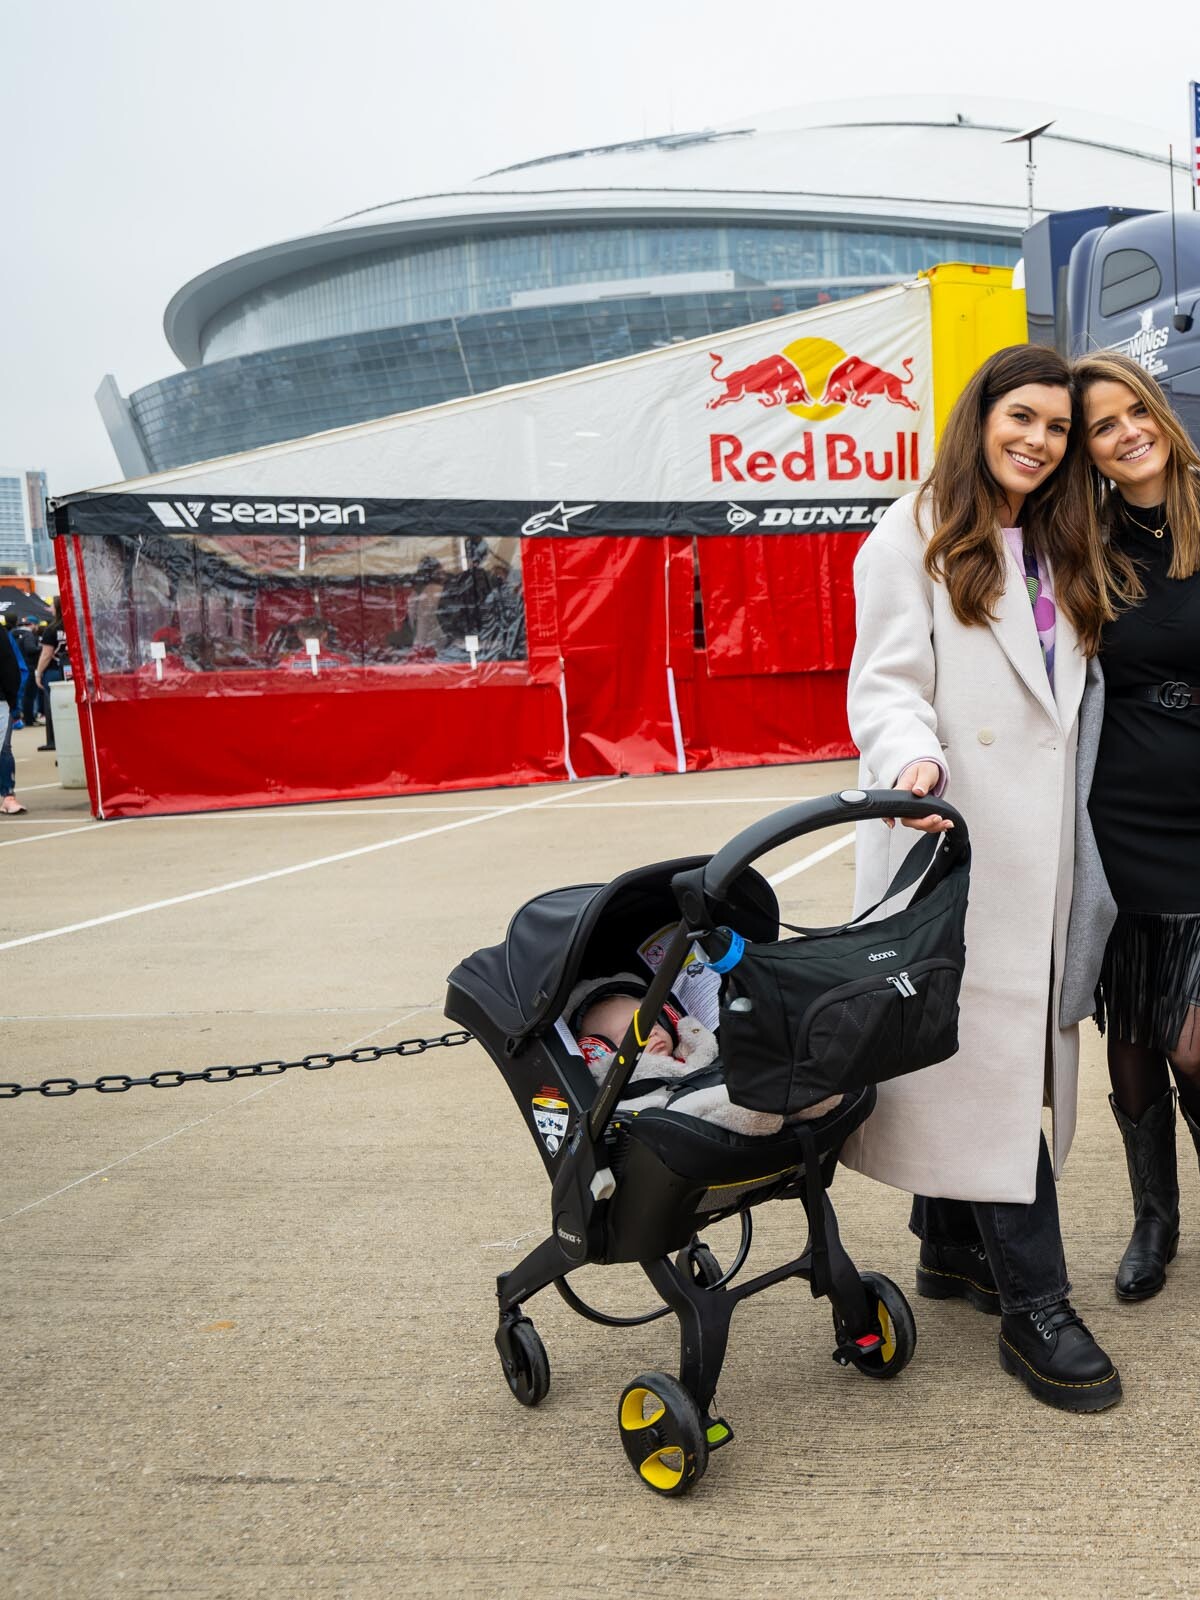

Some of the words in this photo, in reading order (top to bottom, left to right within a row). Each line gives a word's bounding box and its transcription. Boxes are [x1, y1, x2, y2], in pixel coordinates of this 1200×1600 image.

[1129, 327, 1169, 357] WINGS
[709, 432, 815, 482] Red
[825, 432, 919, 481] Bull
[210, 502, 366, 529] seaspan
[868, 950, 897, 962] doona
